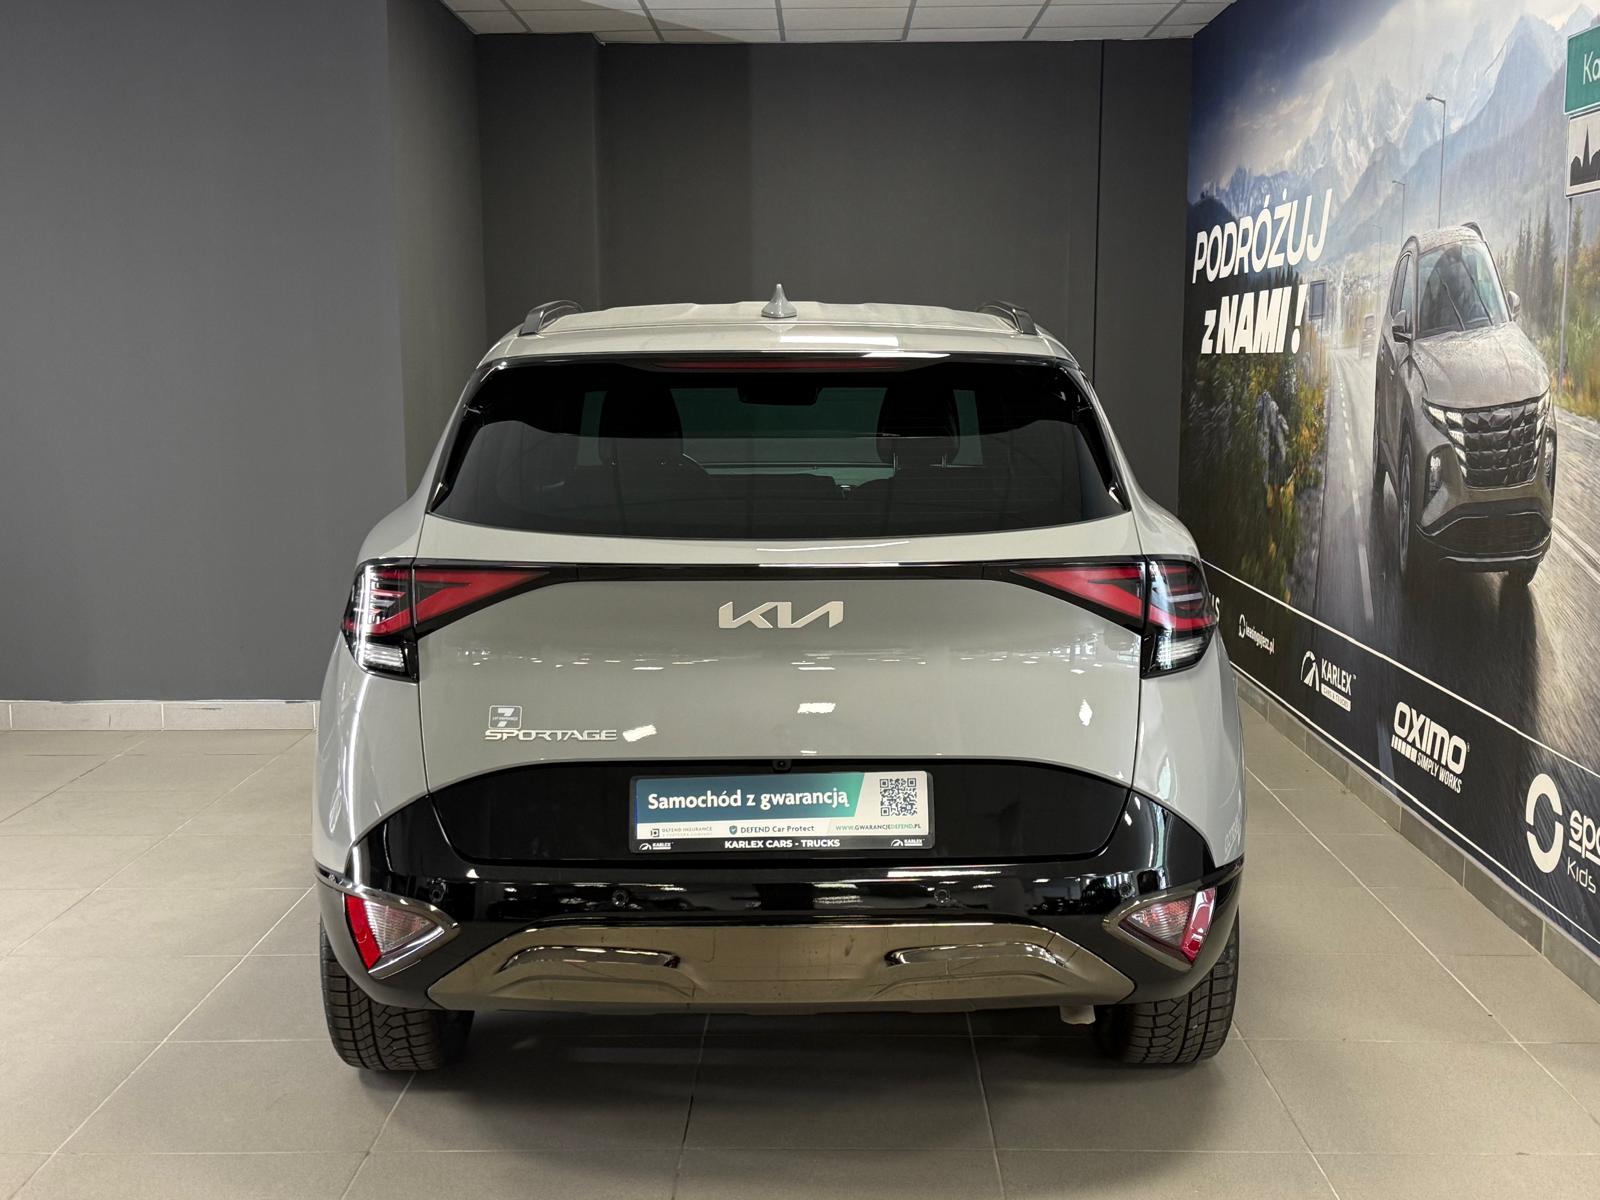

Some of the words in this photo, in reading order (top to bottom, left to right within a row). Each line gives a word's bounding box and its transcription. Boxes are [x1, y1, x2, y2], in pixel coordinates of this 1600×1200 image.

[1192, 188, 1333, 284] PODRÓŻUJ
[1321, 658, 1352, 696] KARLEX
[484, 729, 618, 741] SPORTAGE
[1394, 701, 1467, 774] OXIMO
[1417, 752, 1439, 777] SIMPLY
[1439, 766, 1462, 794] WORKS
[648, 789, 742, 809] Samochód
[746, 793, 756, 806] z
[760, 787, 850, 810] gwarancją
[724, 840, 763, 848] KARLEX
[766, 839, 793, 848] CARS
[801, 839, 841, 848] TRUCKS
